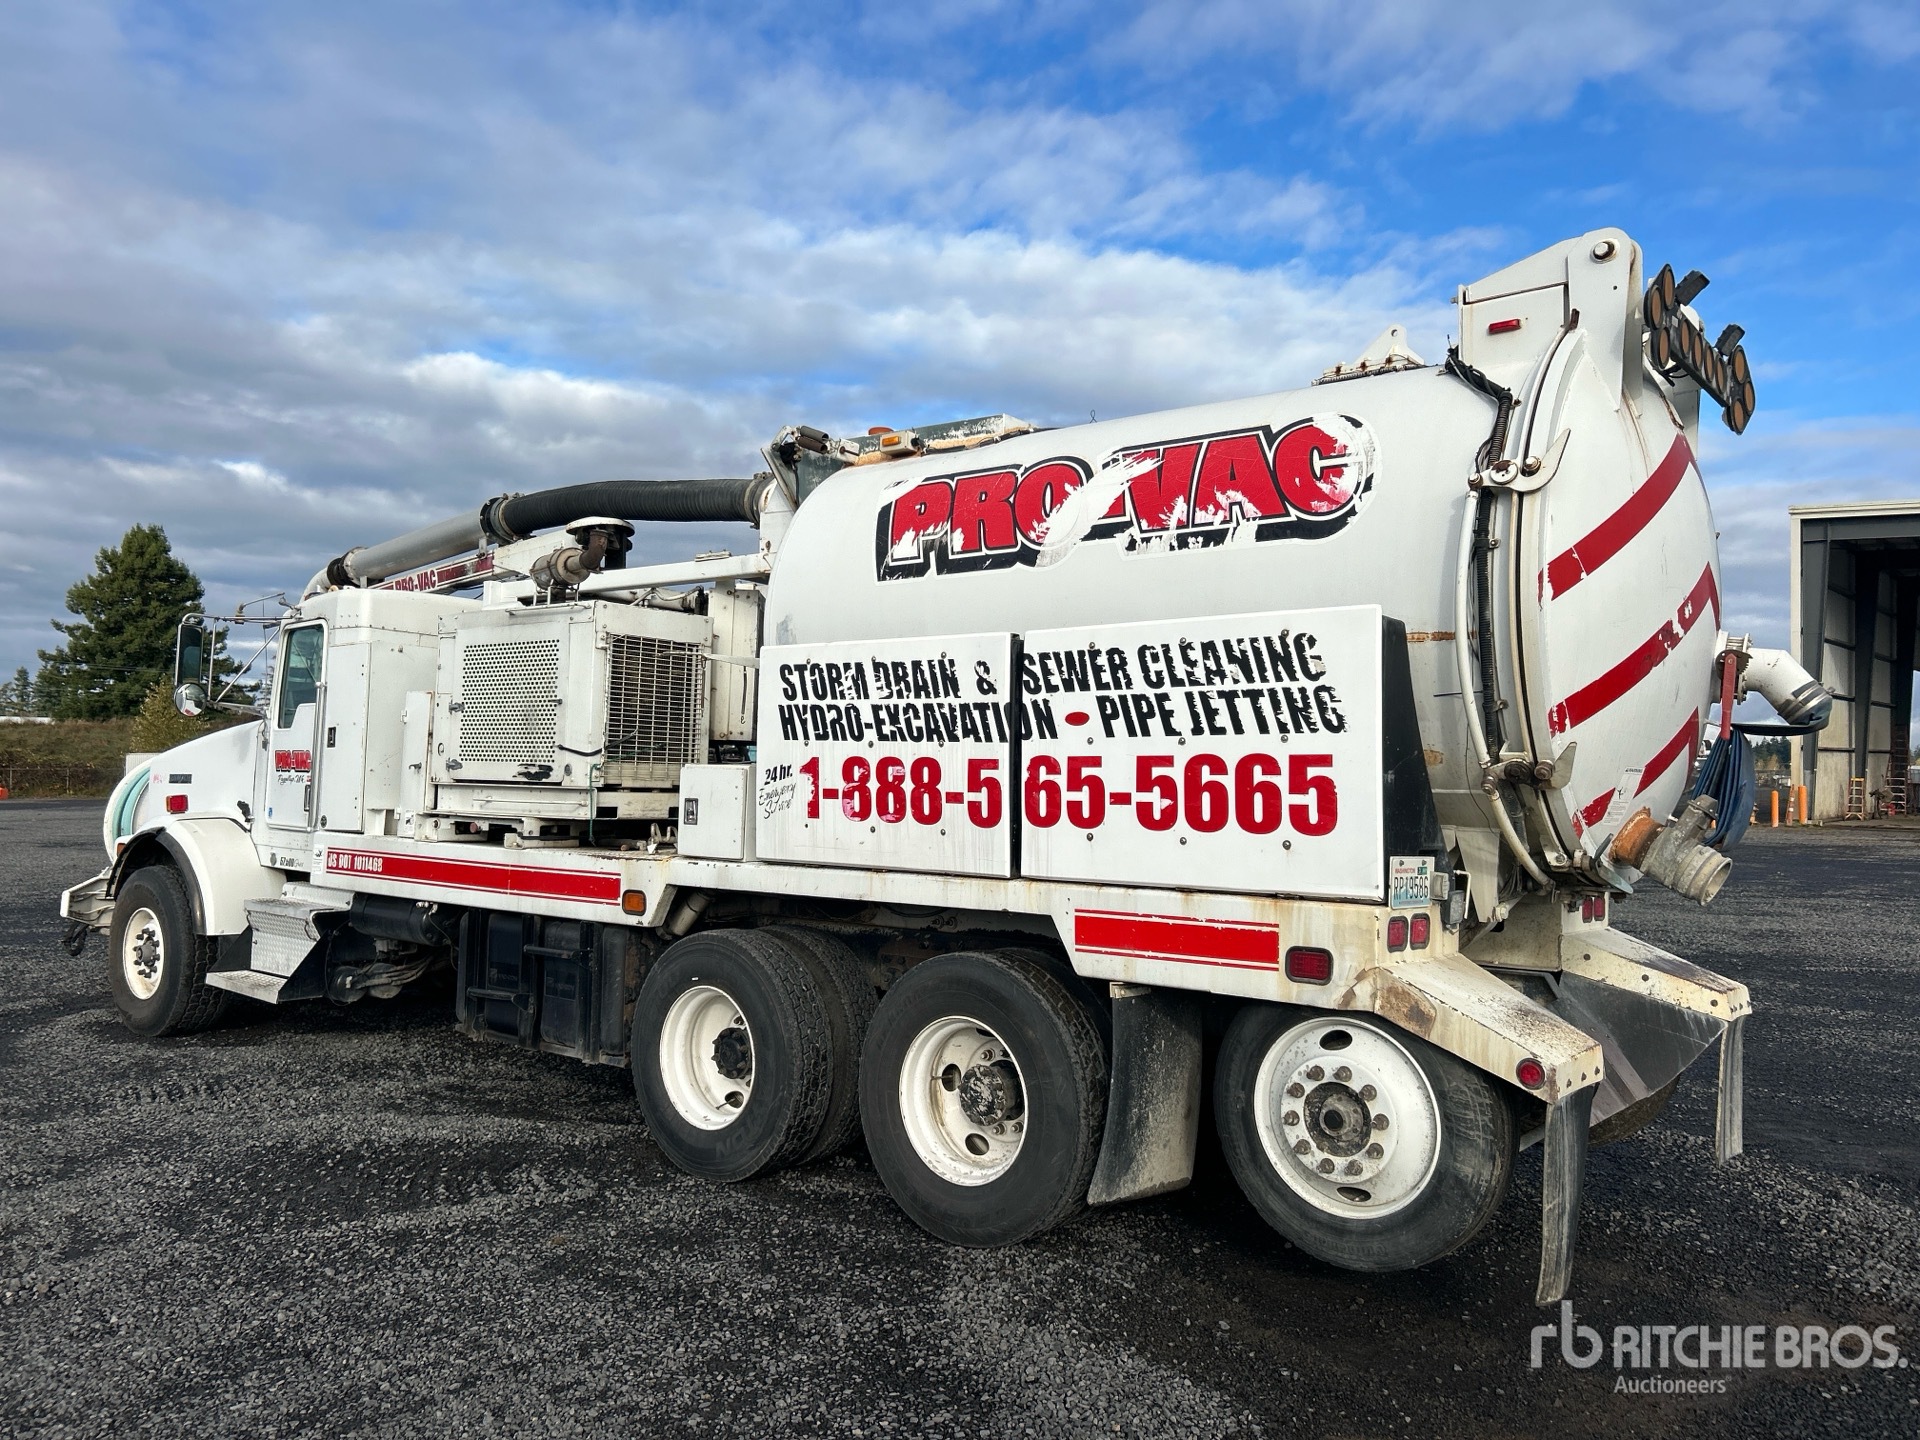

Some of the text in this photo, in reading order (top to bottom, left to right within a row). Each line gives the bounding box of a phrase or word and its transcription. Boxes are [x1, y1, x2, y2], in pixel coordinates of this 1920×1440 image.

[878, 414, 1375, 580] PROVAC
[779, 632, 1327, 701] STORM DRAIN & SEWER CLEANING
[1096, 691, 1183, 739] PIPE
[1186, 684, 1350, 737] JETTING
[764, 766, 778, 785] 24
[339, 854, 352, 869] DOT
